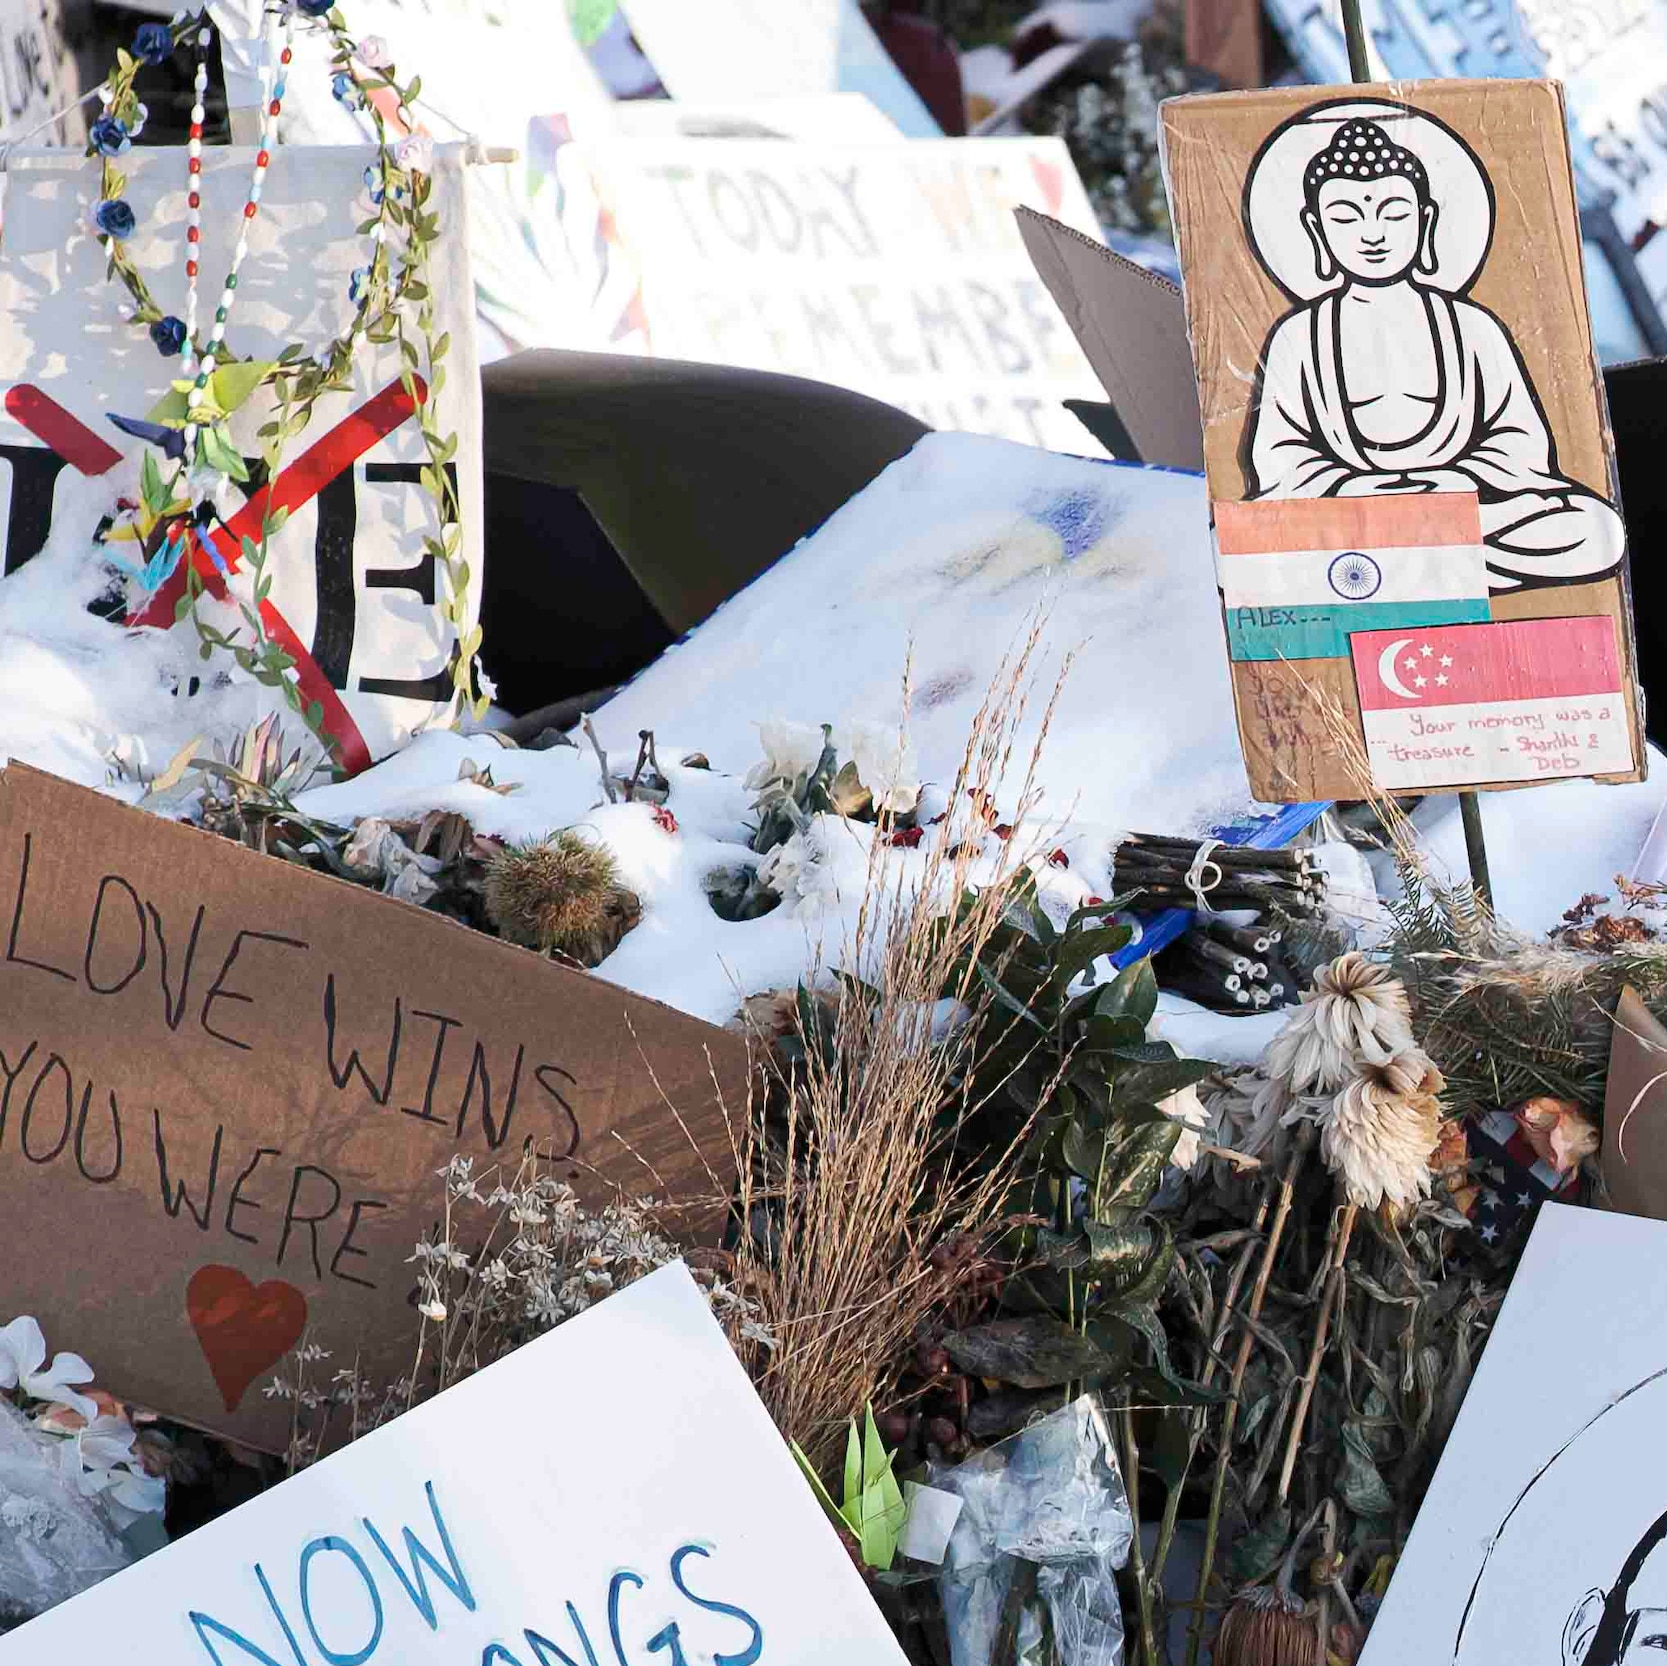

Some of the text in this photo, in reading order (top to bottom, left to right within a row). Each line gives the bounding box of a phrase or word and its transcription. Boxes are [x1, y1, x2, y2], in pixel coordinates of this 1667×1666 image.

[1409, 707, 1611, 736] Your memory was a
[1387, 743, 1475, 763] treasure
[1528, 754, 1582, 771] Deb
[6, 831, 310, 1051] LOVE
[0, 1040, 388, 1290] YOU WERE
